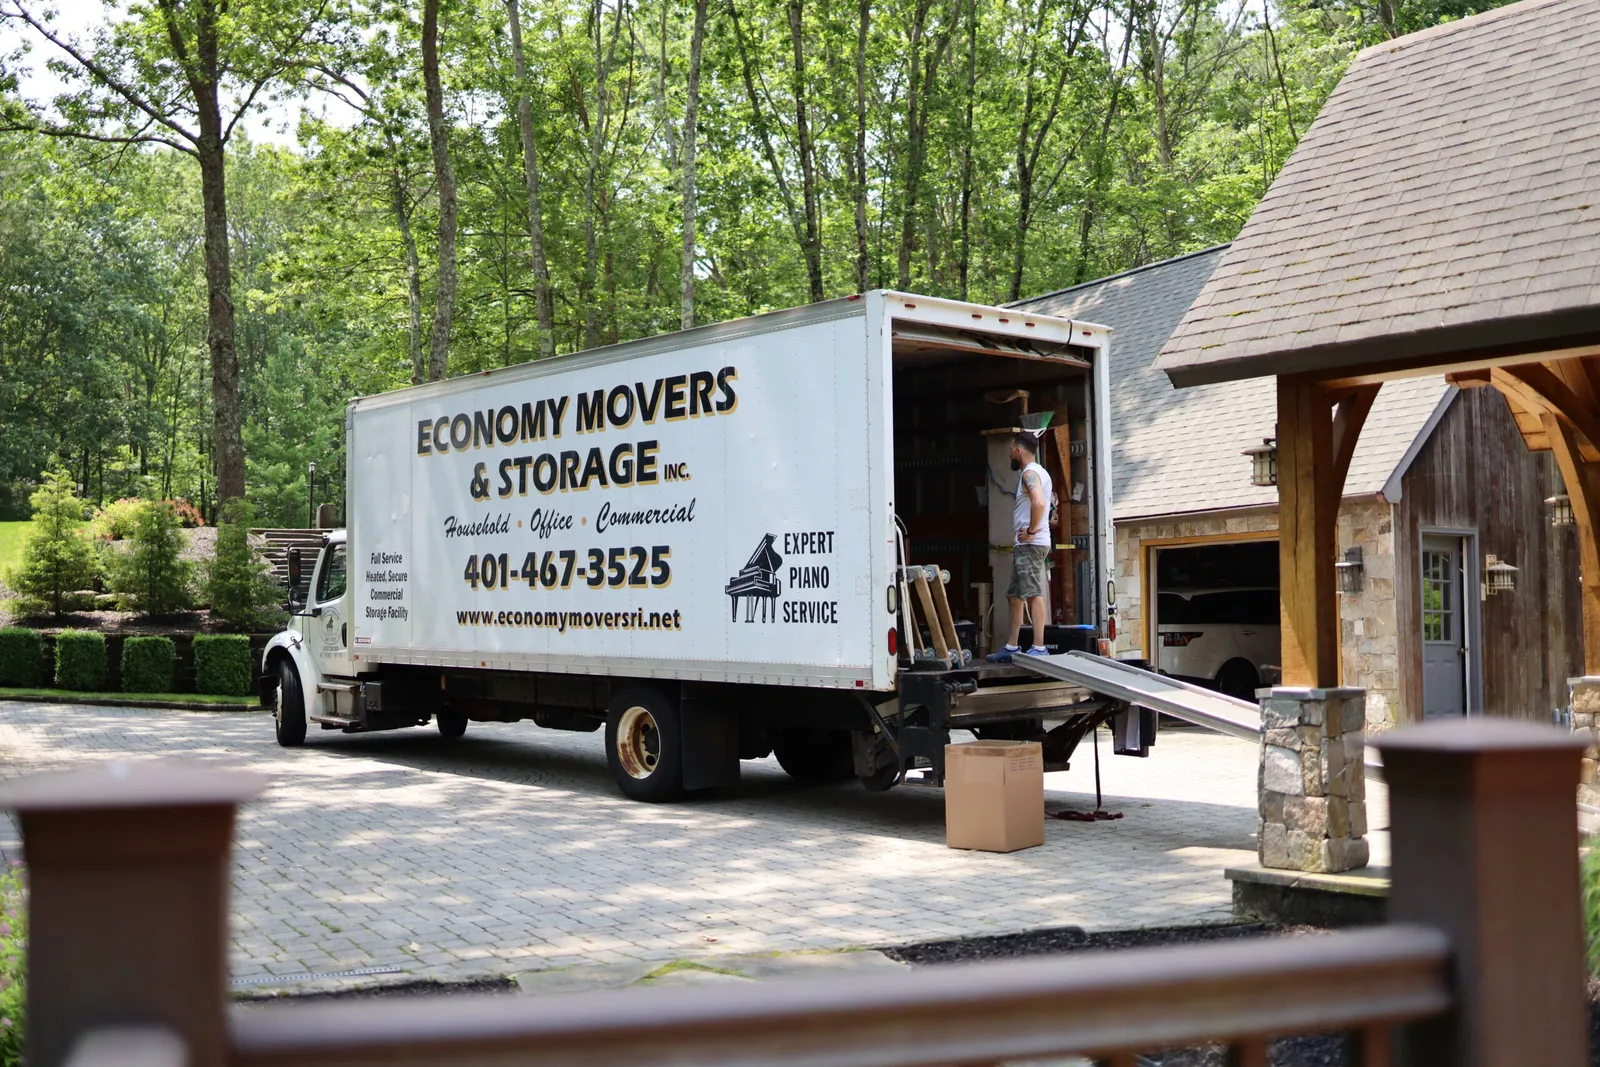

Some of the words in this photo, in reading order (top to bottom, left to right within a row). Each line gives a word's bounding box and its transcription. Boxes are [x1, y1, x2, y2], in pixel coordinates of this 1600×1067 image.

[417, 396, 570, 455] ECONOMY
[576, 366, 737, 432] MOVERS
[470, 462, 490, 501] &
[498, 439, 660, 498] STORAGE
[664, 463, 691, 482] INC.
[444, 512, 511, 538] Household
[530, 507, 573, 540] Office
[596, 497, 696, 534] Commercial
[784, 532, 834, 554] EXPERT
[370, 552, 381, 564] Full
[382, 552, 402, 564] Service
[465, 546, 672, 590] 401-467-3525
[366, 570, 387, 583] Heated,
[388, 570, 407, 581] Secure
[790, 565, 829, 589] PIANO
[370, 588, 403, 600] Commercial
[365, 606, 387, 621] Storage
[388, 606, 408, 621] Facility
[456, 608, 682, 634] www.economymoversri.net
[783, 601, 837, 624] SERVICE
